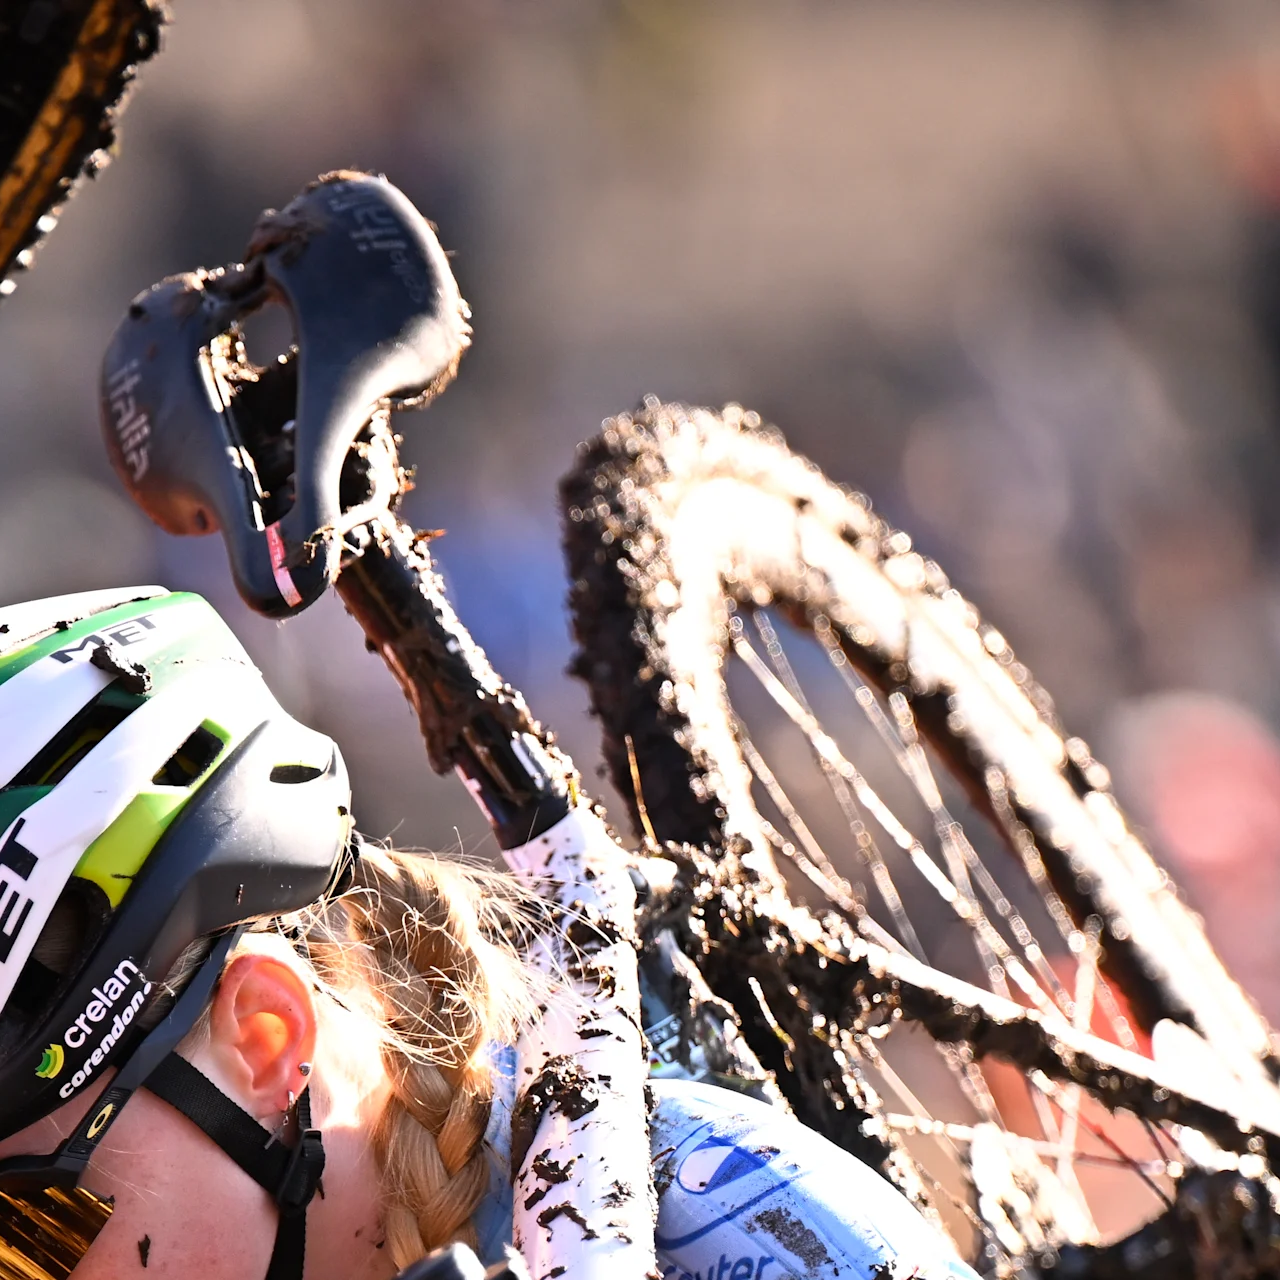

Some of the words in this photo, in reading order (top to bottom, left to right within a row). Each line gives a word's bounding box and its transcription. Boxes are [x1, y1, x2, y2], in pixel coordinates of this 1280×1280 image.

[107, 358, 151, 483] italia
[49, 613, 157, 665] MET
[63, 958, 140, 1051] crelan
